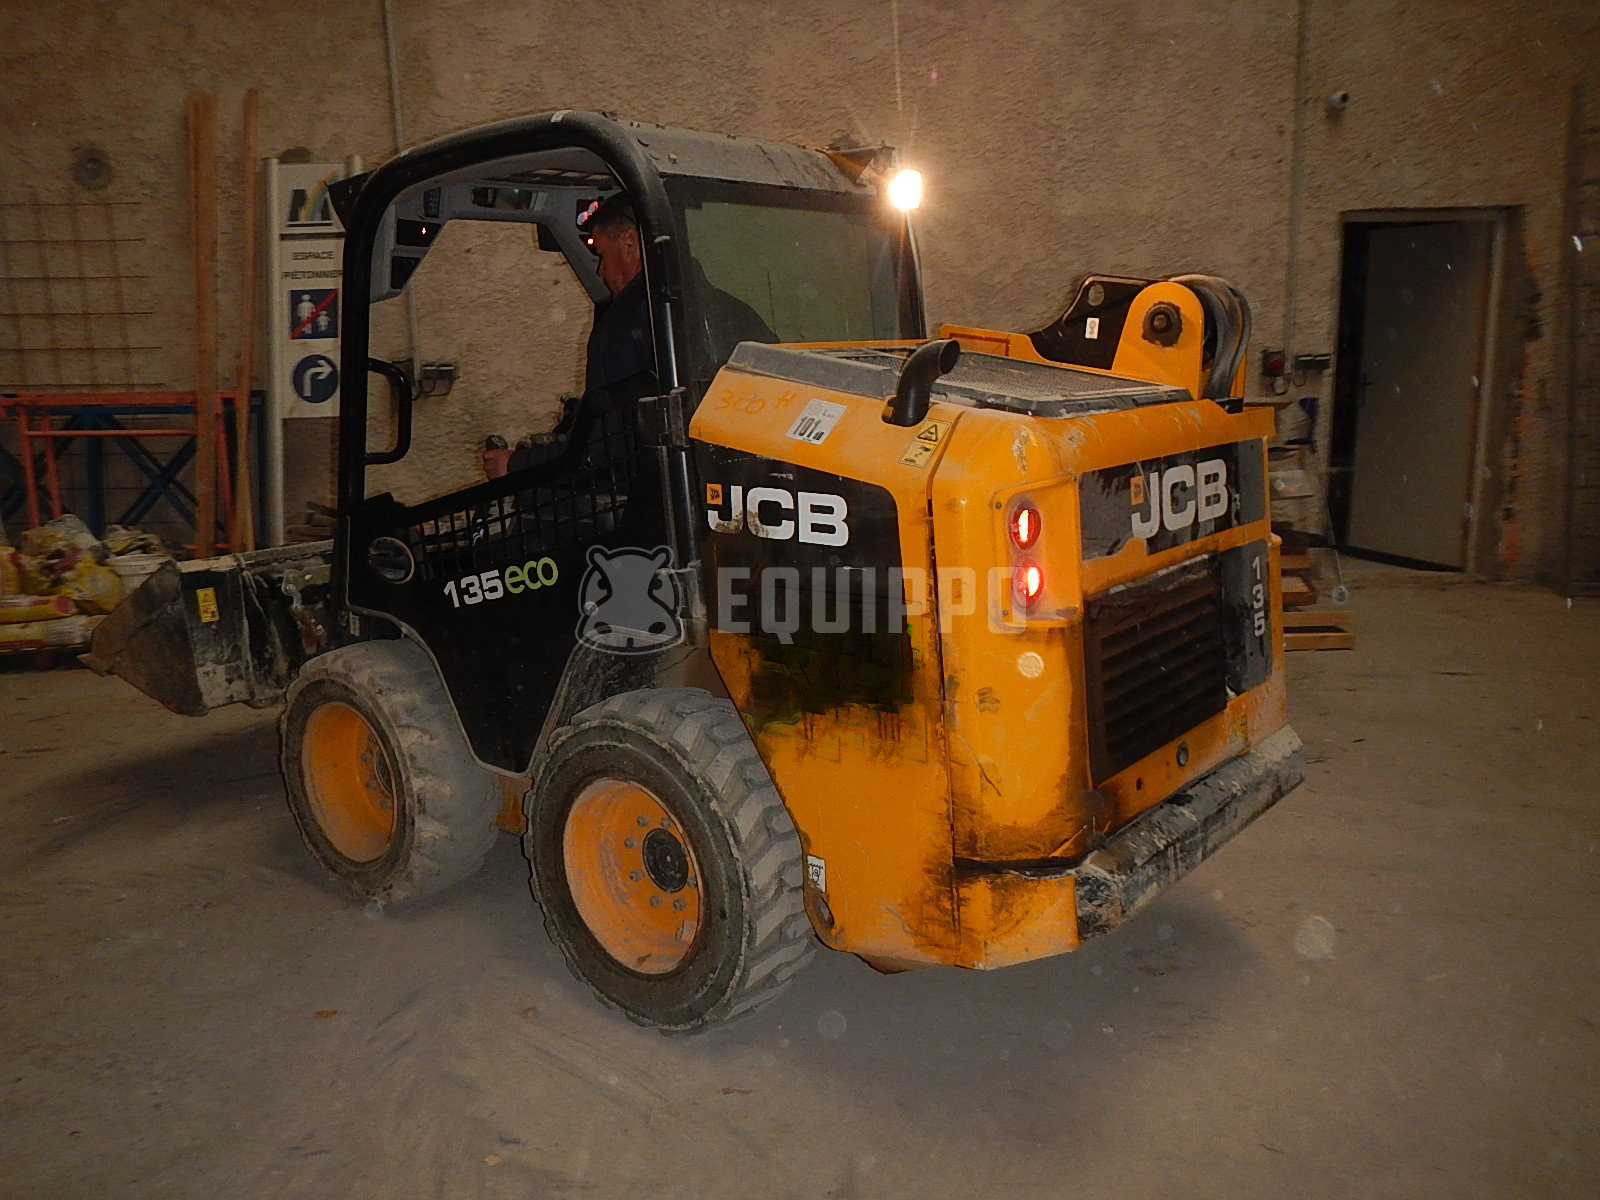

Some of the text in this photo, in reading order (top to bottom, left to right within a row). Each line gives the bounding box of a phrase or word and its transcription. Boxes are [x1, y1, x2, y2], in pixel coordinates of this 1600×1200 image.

[292, 250, 335, 261] ESPACE
[707, 485, 849, 547] JCB
[1131, 458, 1229, 539] JCB
[1252, 556, 1266, 637] 135
